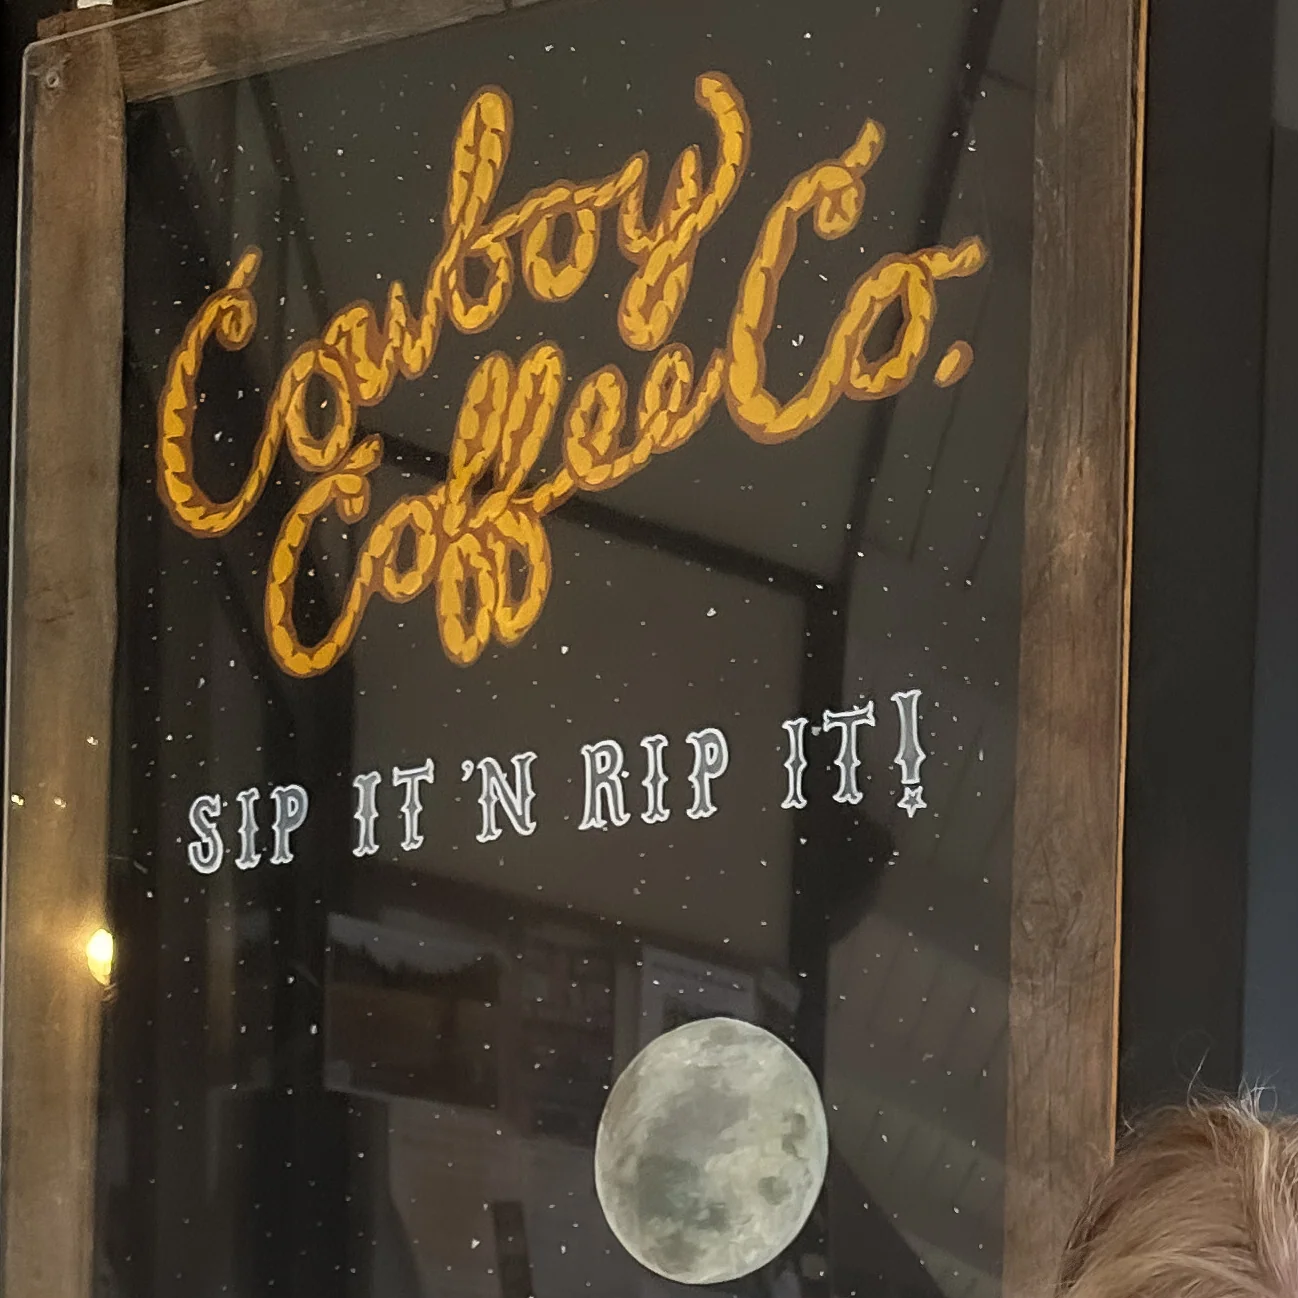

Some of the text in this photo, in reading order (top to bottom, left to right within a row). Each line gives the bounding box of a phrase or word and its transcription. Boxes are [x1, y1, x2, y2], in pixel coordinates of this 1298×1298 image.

[158, 71, 750, 536] Cowboy
[265, 118, 987, 677] Coffee Co.
[187, 784, 309, 875] SIP
[578, 726, 730, 831] RIP
[781, 689, 927, 819] IT!
